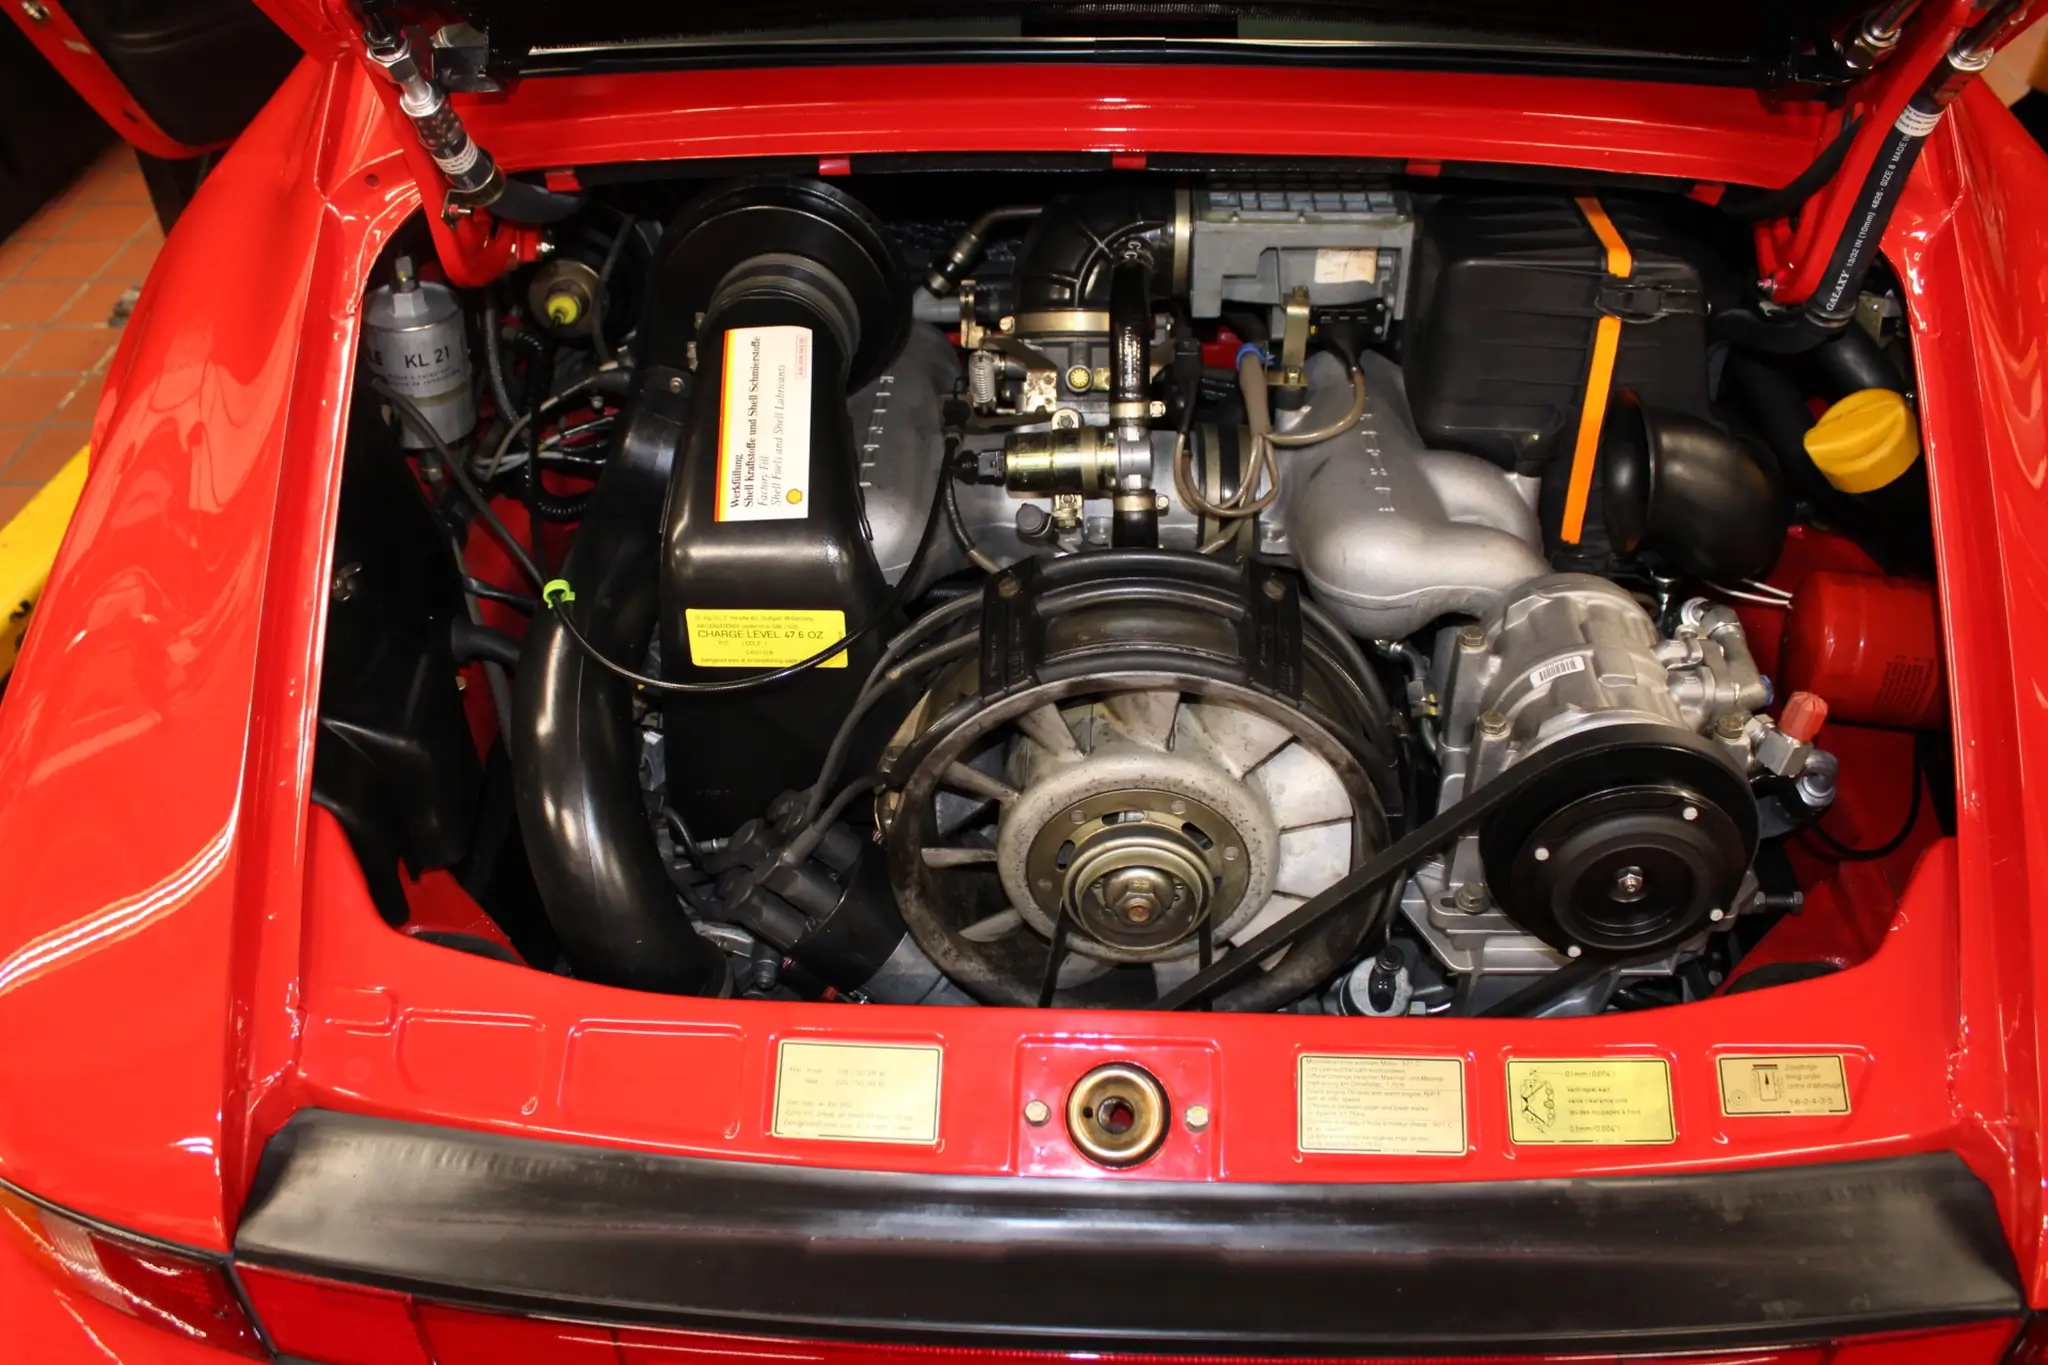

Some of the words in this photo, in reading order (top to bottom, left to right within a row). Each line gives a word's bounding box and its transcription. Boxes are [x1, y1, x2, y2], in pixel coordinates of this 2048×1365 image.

[1891, 141, 1908, 162] MADE
[1880, 170, 1894, 187] SIZE
[1858, 211, 1876, 239] (10mm)
[1854, 239, 1864, 249] IN
[1846, 248, 1860, 267] 13/32
[1826, 269, 1850, 311] GALAXY
[404, 353, 430, 369] KL
[434, 346, 450, 364] 21
[748, 336, 761, 393] Schmierstoffe
[774, 364, 786, 410] Lubricants
[747, 394, 759, 417] Shell
[747, 419, 757, 436] und
[773, 412, 785, 435] Shell
[773, 437, 783, 453] and
[744, 437, 757, 482] Kraftstoffe
[759, 455, 770, 470] Fill
[772, 456, 783, 481] Fuels
[730, 453, 744, 508] Werkfüllung
[757, 473, 771, 506] Factory
[743, 484, 754, 508] Shell
[770, 482, 782, 506] Shell
[697, 630, 744, 638] CHARGE
[747, 630, 780, 638] LEVEL
[784, 630, 804, 639] 47.6
[807, 630, 824, 639] OZ
